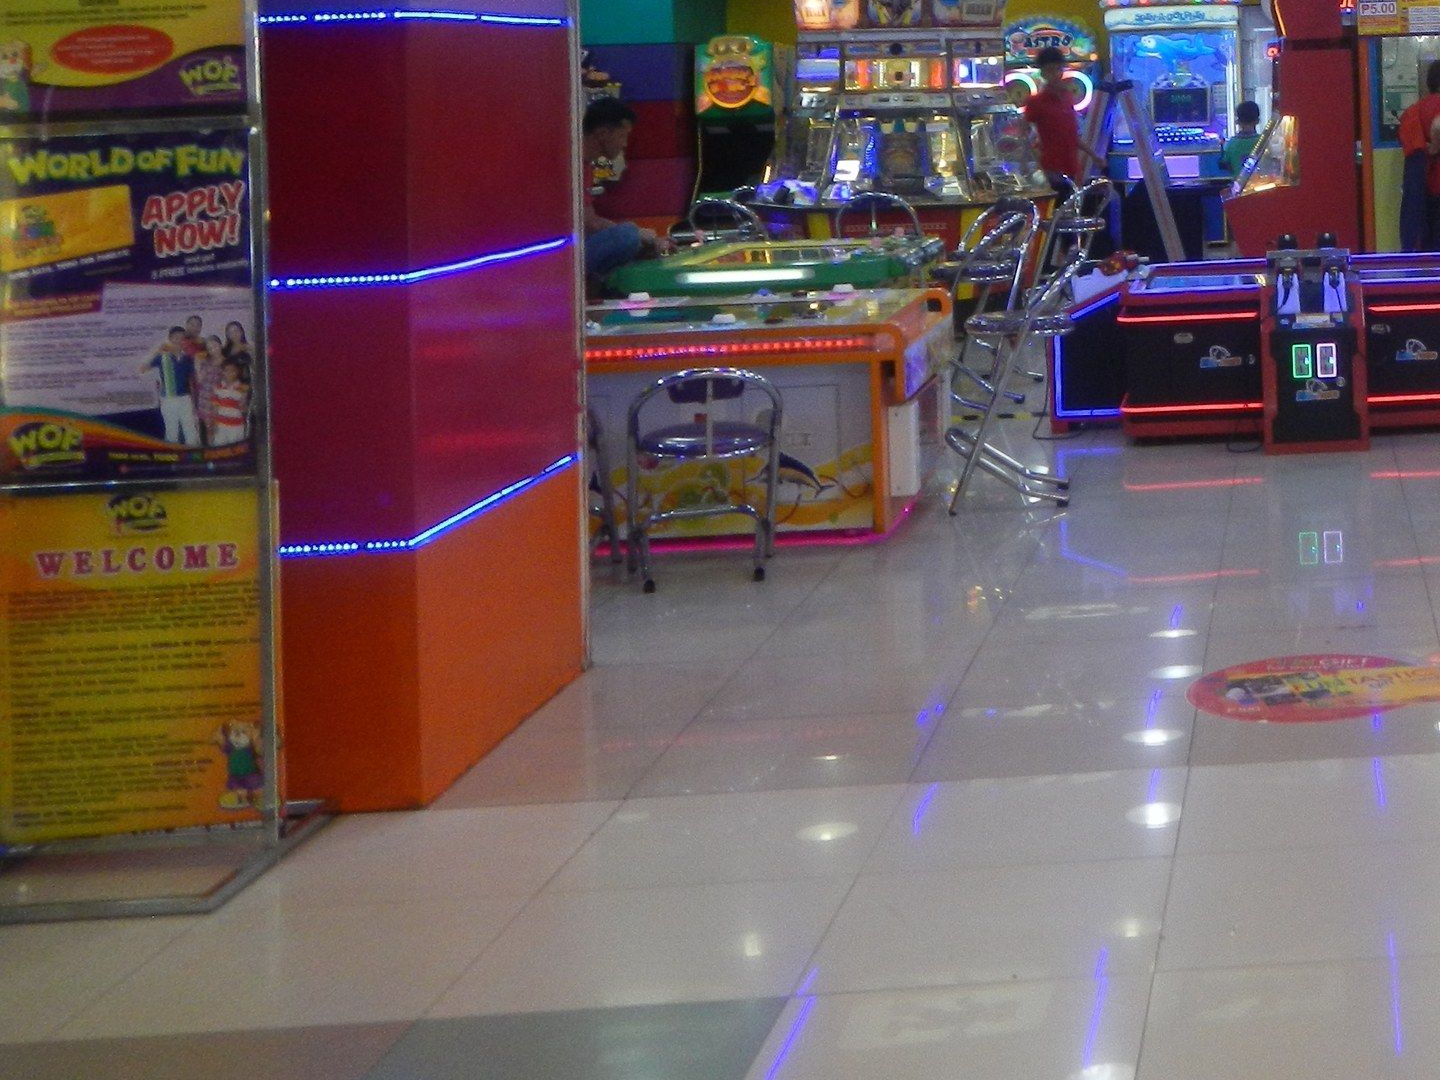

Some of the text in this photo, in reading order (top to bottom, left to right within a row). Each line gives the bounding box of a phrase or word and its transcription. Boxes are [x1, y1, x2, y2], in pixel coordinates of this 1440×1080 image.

[8, 145, 245, 184] WORLD OF FUN
[142, 180, 245, 229] APPLY
[154, 212, 240, 258] NOW!
[9, 423, 83, 456] WOF
[36, 542, 239, 578] WELCOME
